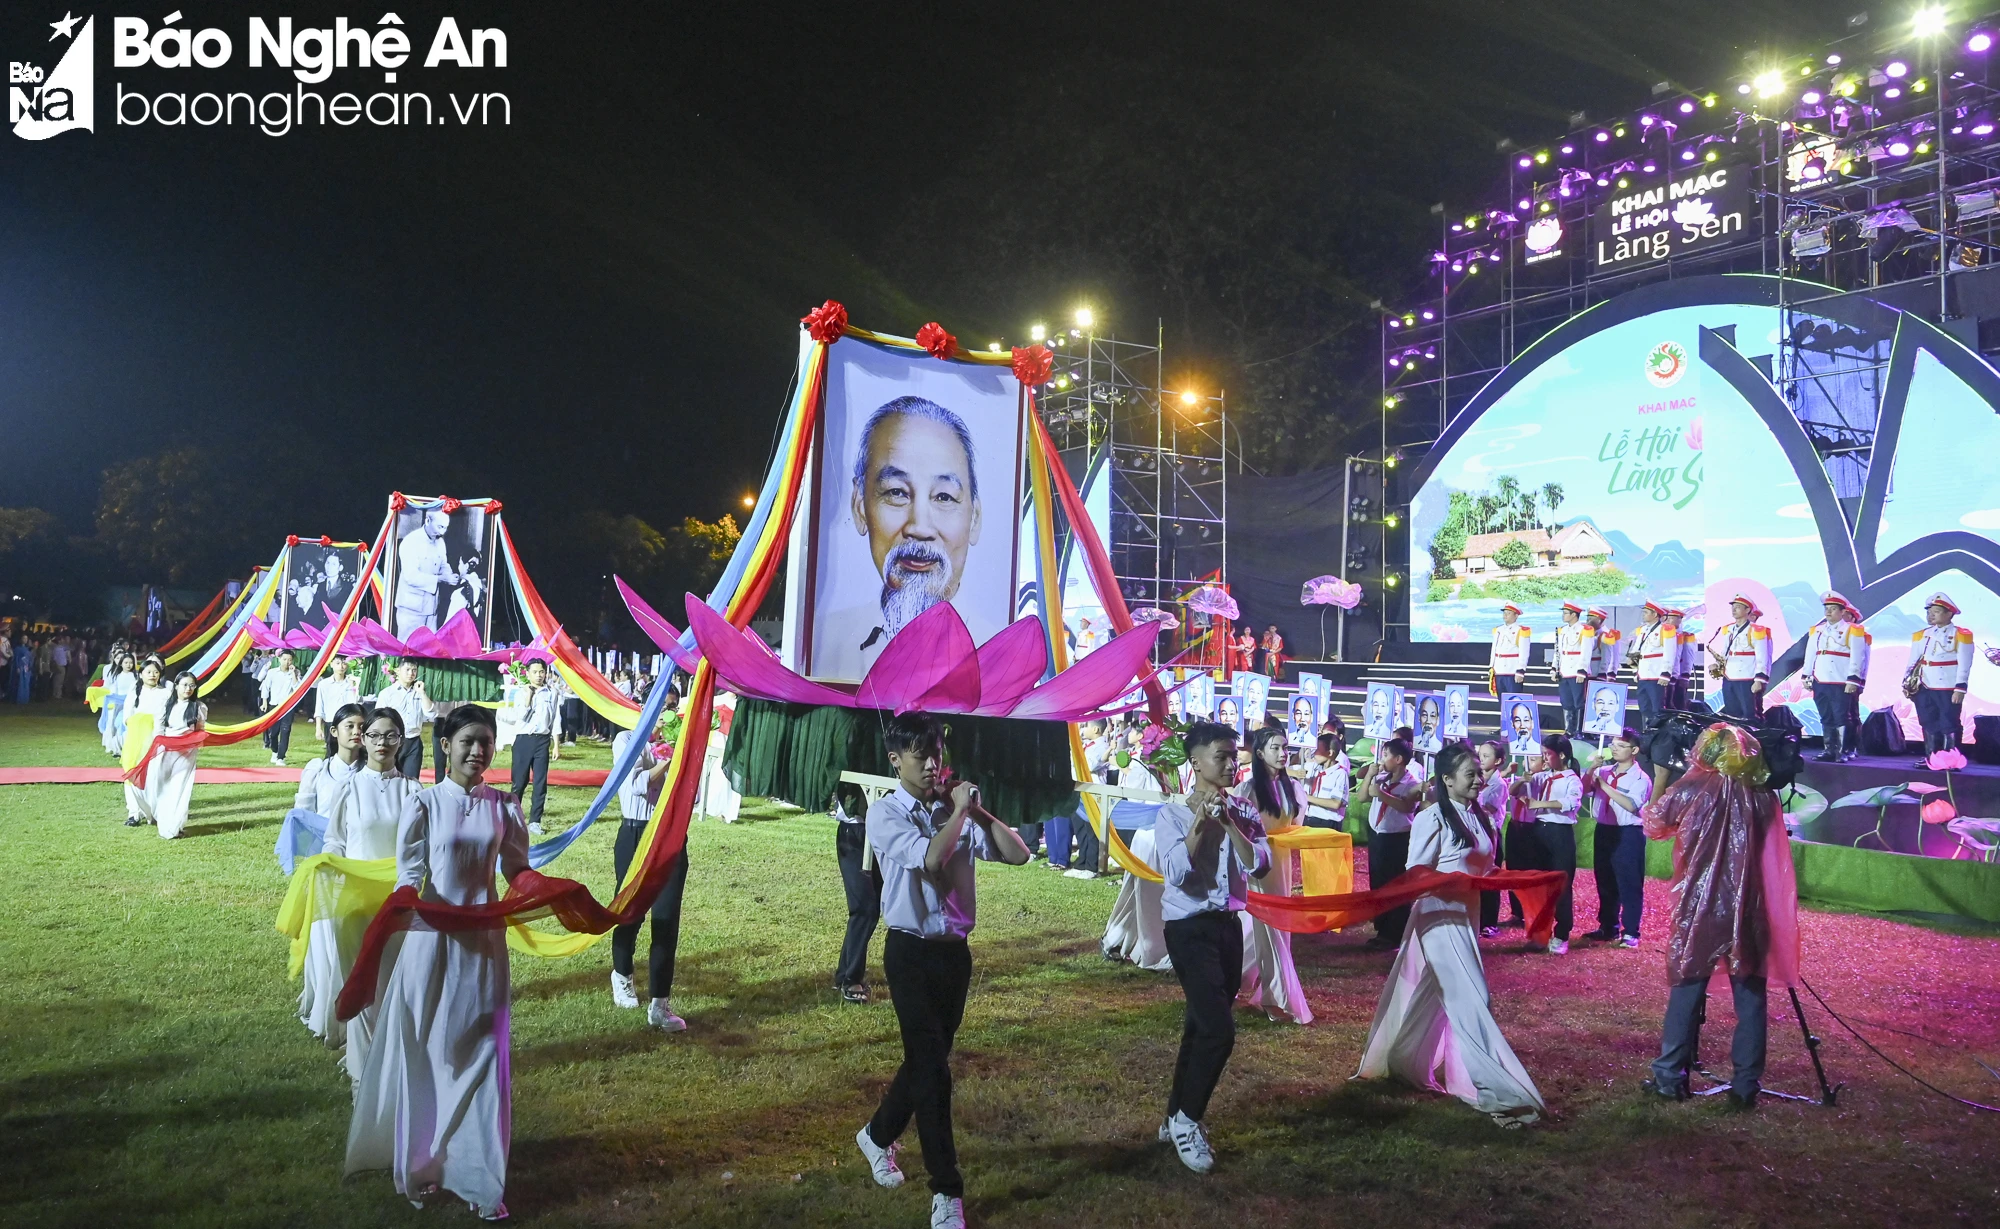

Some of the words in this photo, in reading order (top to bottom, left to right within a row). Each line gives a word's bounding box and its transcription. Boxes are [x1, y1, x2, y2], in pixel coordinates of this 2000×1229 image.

[1611, 186, 1664, 217] KHAI
[1669, 169, 1727, 200] MẠC
[1634, 207, 1669, 227] HỘI
[1597, 229, 1671, 266] Làng
[1638, 401, 1667, 415] KHAI
[1669, 396, 1697, 411] MẠC
[1598, 428, 1632, 462] Lễ
[1634, 425, 1682, 462] Hội
[1607, 460, 1679, 502] Làng
